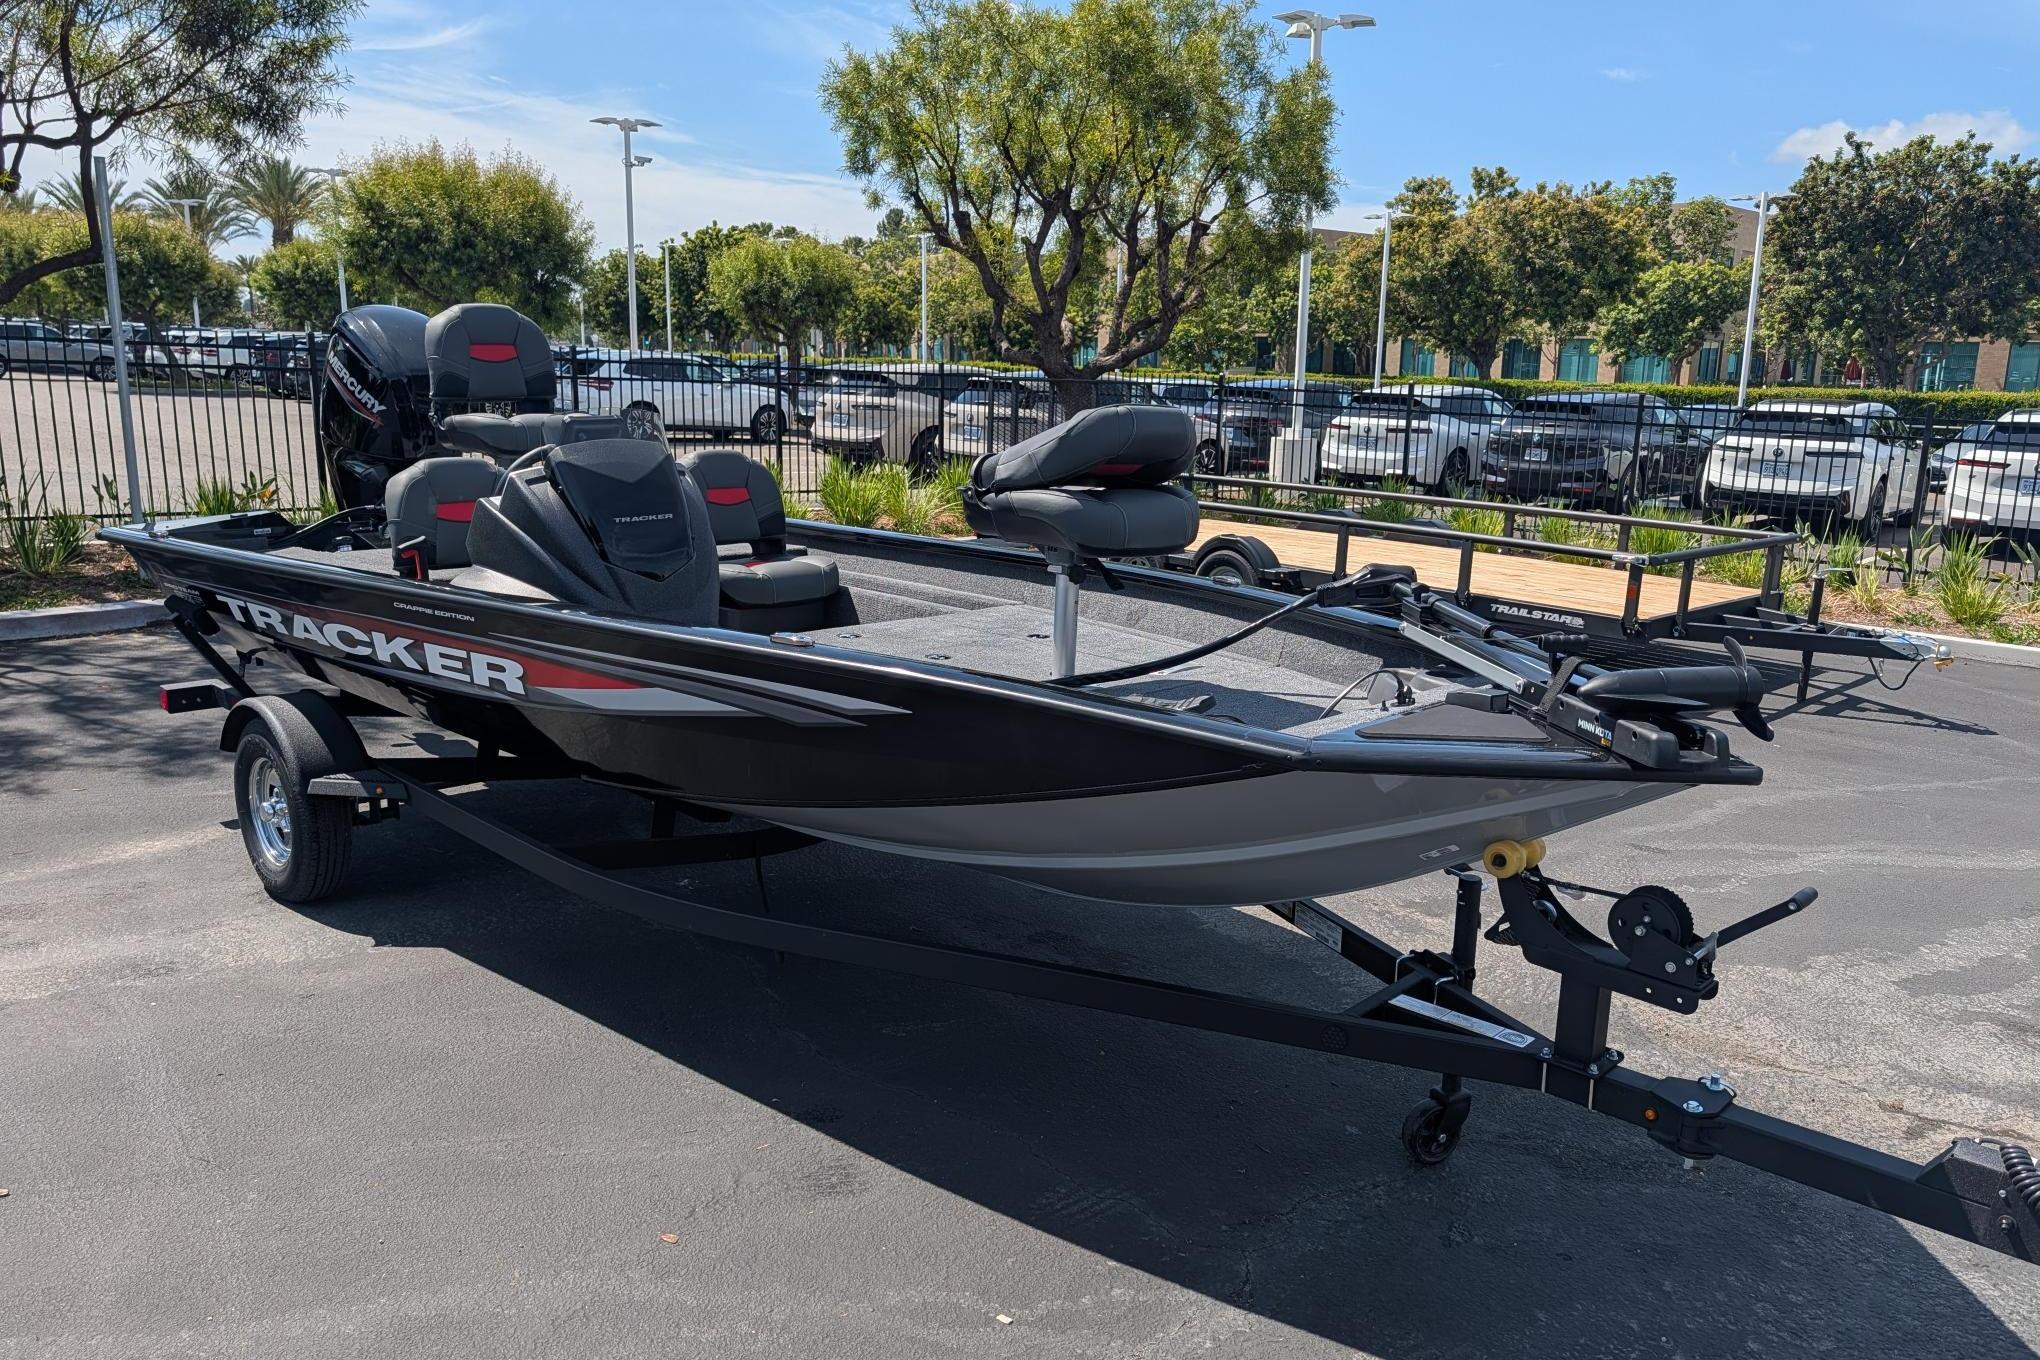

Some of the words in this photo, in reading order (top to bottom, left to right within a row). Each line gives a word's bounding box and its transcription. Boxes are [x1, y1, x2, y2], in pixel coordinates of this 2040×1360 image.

[328, 350, 388, 414] MERCURY
[613, 513, 673, 523] TRACKER
[393, 602, 433, 615] CRAPPIE
[434, 609, 475, 622] EDITION
[1490, 603, 1573, 625] TRAILSTAR
[215, 594, 526, 696] TRACKER
[1577, 717, 1595, 734] MINN
[1595, 725, 1612, 741] KOTA
